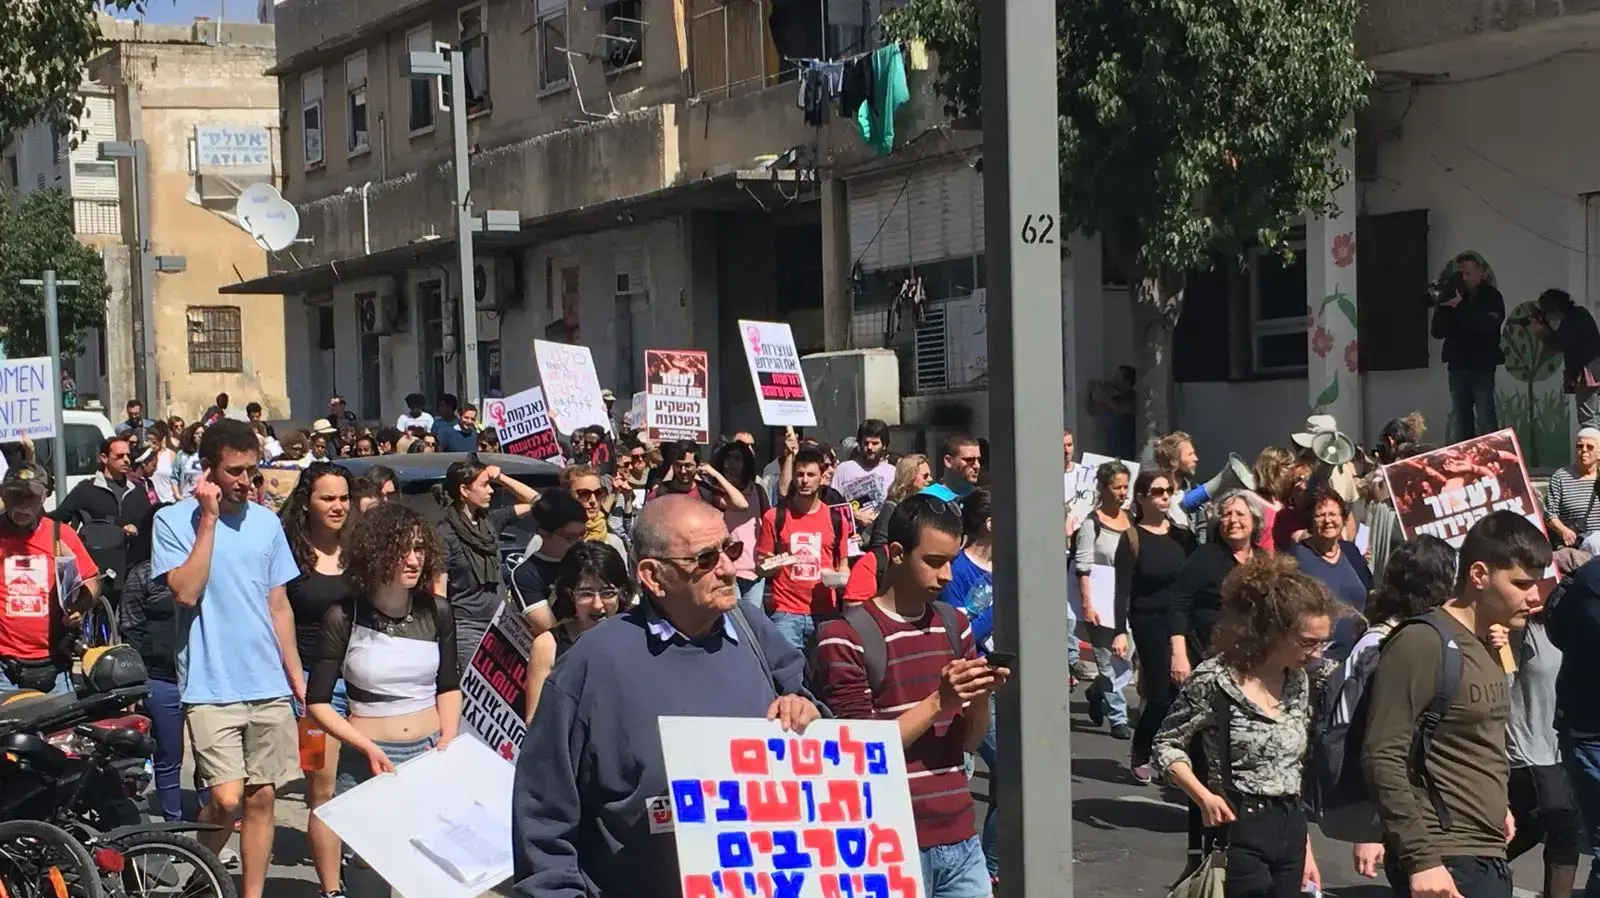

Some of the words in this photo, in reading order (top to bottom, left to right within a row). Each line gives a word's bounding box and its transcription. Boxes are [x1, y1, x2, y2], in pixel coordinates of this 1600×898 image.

[1021, 214, 1054, 244] 62
[506, 400, 545, 424] נאבקות
[655, 399, 701, 413] להשקיע
[655, 413, 701, 427] בשכונות
[499, 415, 549, 441] בסקסיזם
[1423, 475, 1501, 518] לעצור
[461, 697, 504, 752] וצרות
[730, 724, 889, 777] פליטים
[671, 779, 873, 824] ותושבים
[717, 822, 905, 869] מסרבים
